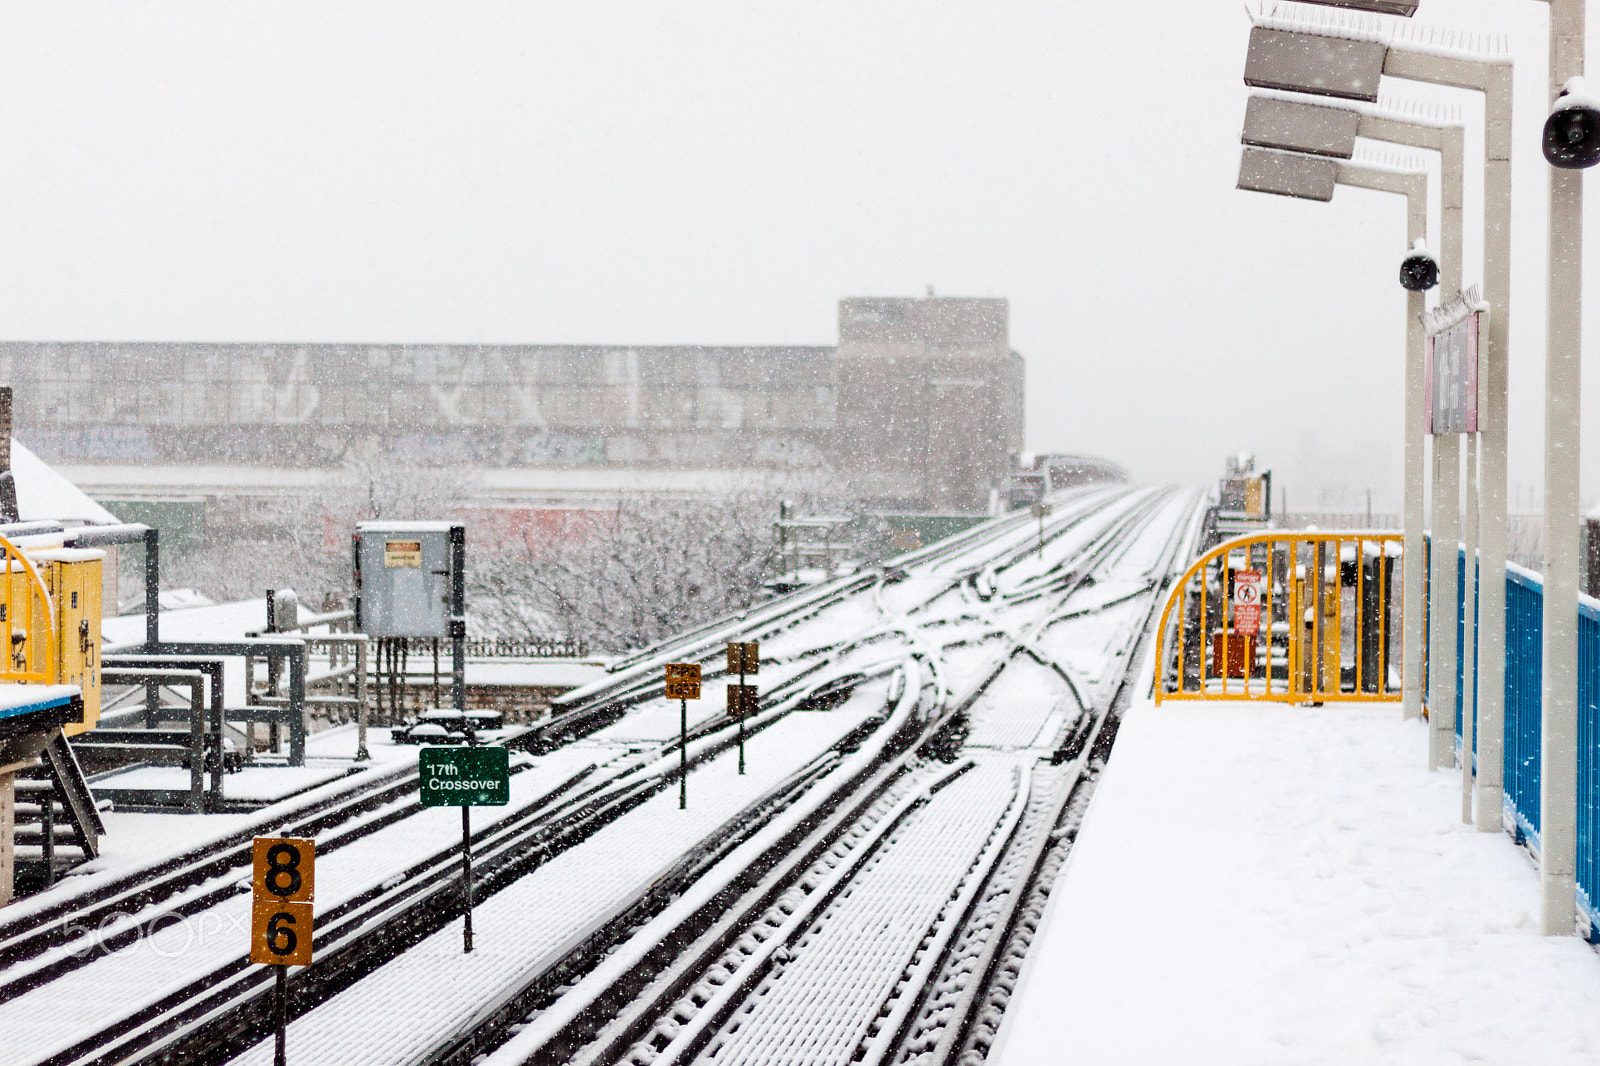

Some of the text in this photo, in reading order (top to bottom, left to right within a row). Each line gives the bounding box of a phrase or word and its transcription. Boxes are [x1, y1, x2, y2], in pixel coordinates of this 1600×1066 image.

[429, 764, 458, 776] 17th
[429, 778, 501, 790] Crossover
[265, 843, 301, 897] 8
[266, 912, 298, 956] 6
